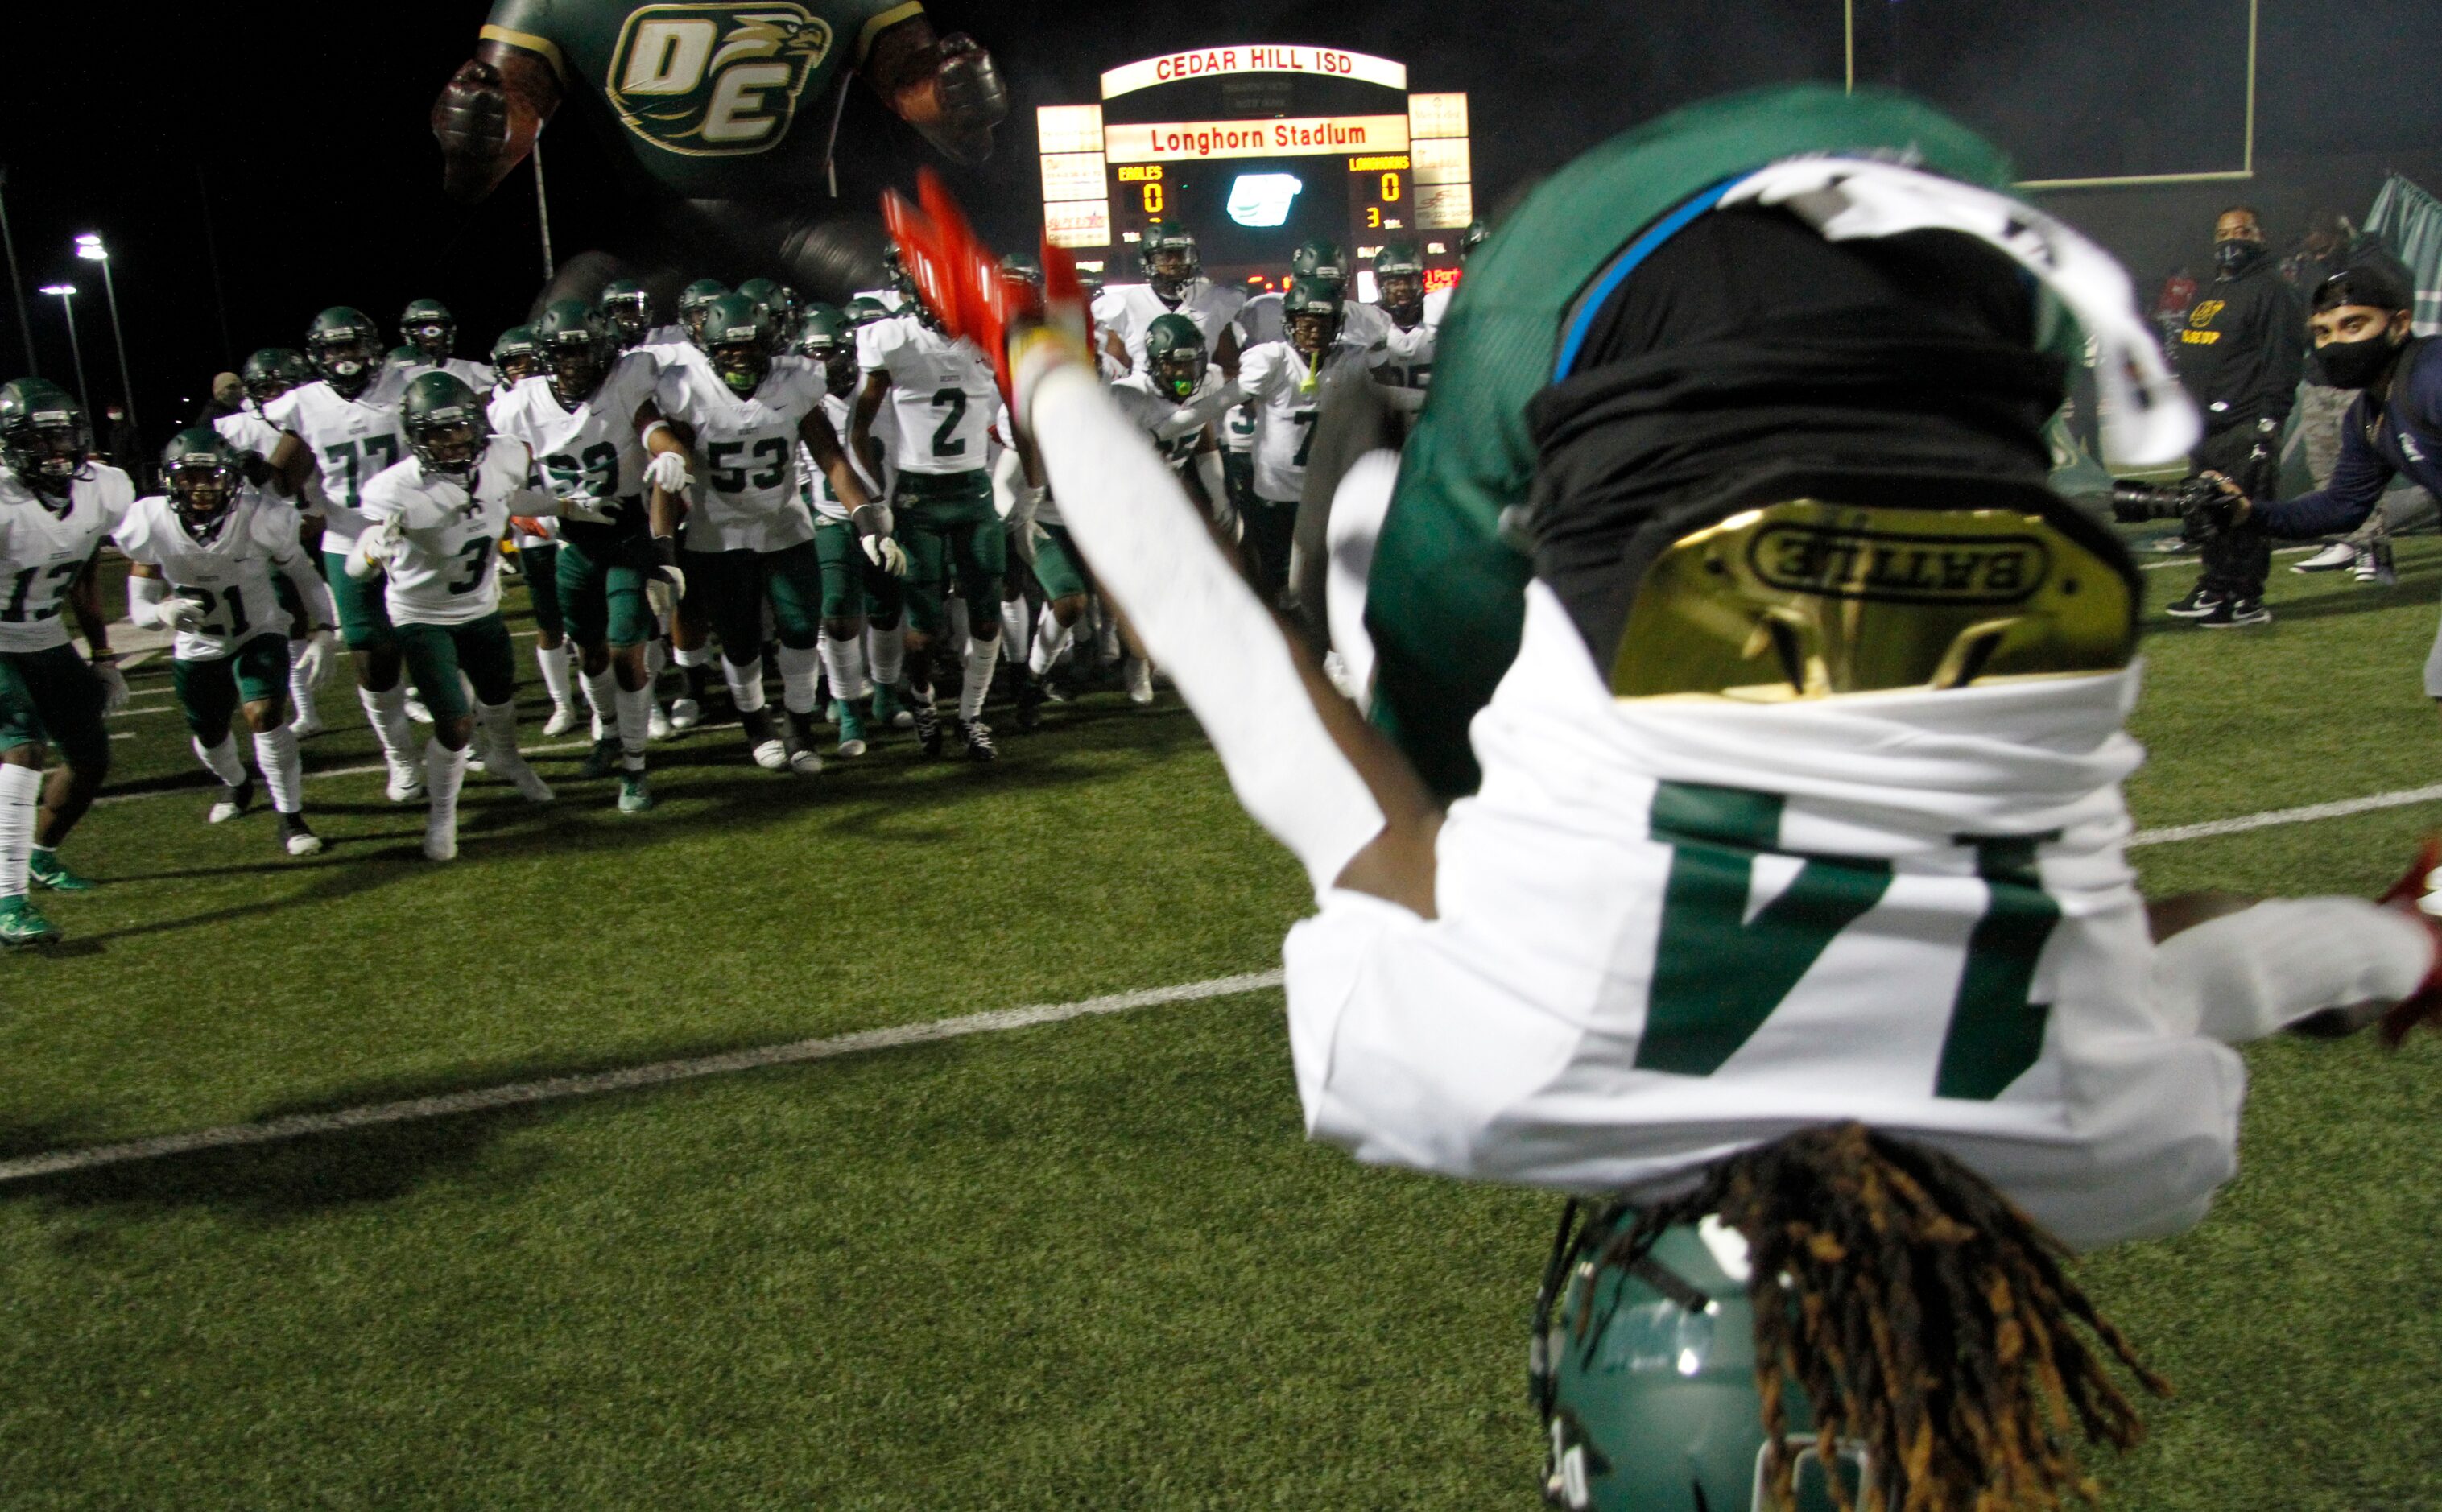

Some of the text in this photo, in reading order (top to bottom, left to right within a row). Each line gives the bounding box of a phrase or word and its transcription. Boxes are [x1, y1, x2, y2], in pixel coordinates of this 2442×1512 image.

[1156, 48, 1352, 80] CEDAR HILL ISD
[1151, 123, 1366, 155] Longhorn Stadium
[1118, 166, 1163, 181] EAGLES
[1381, 172, 1400, 202] 0
[1143, 183, 1163, 213] 0
[1366, 207, 1381, 229] 3
[932, 387, 967, 457] 2
[324, 432, 399, 510] 77
[708, 436, 789, 493] 53
[448, 535, 494, 595] 3
[1776, 539, 2024, 590] BATTLE
